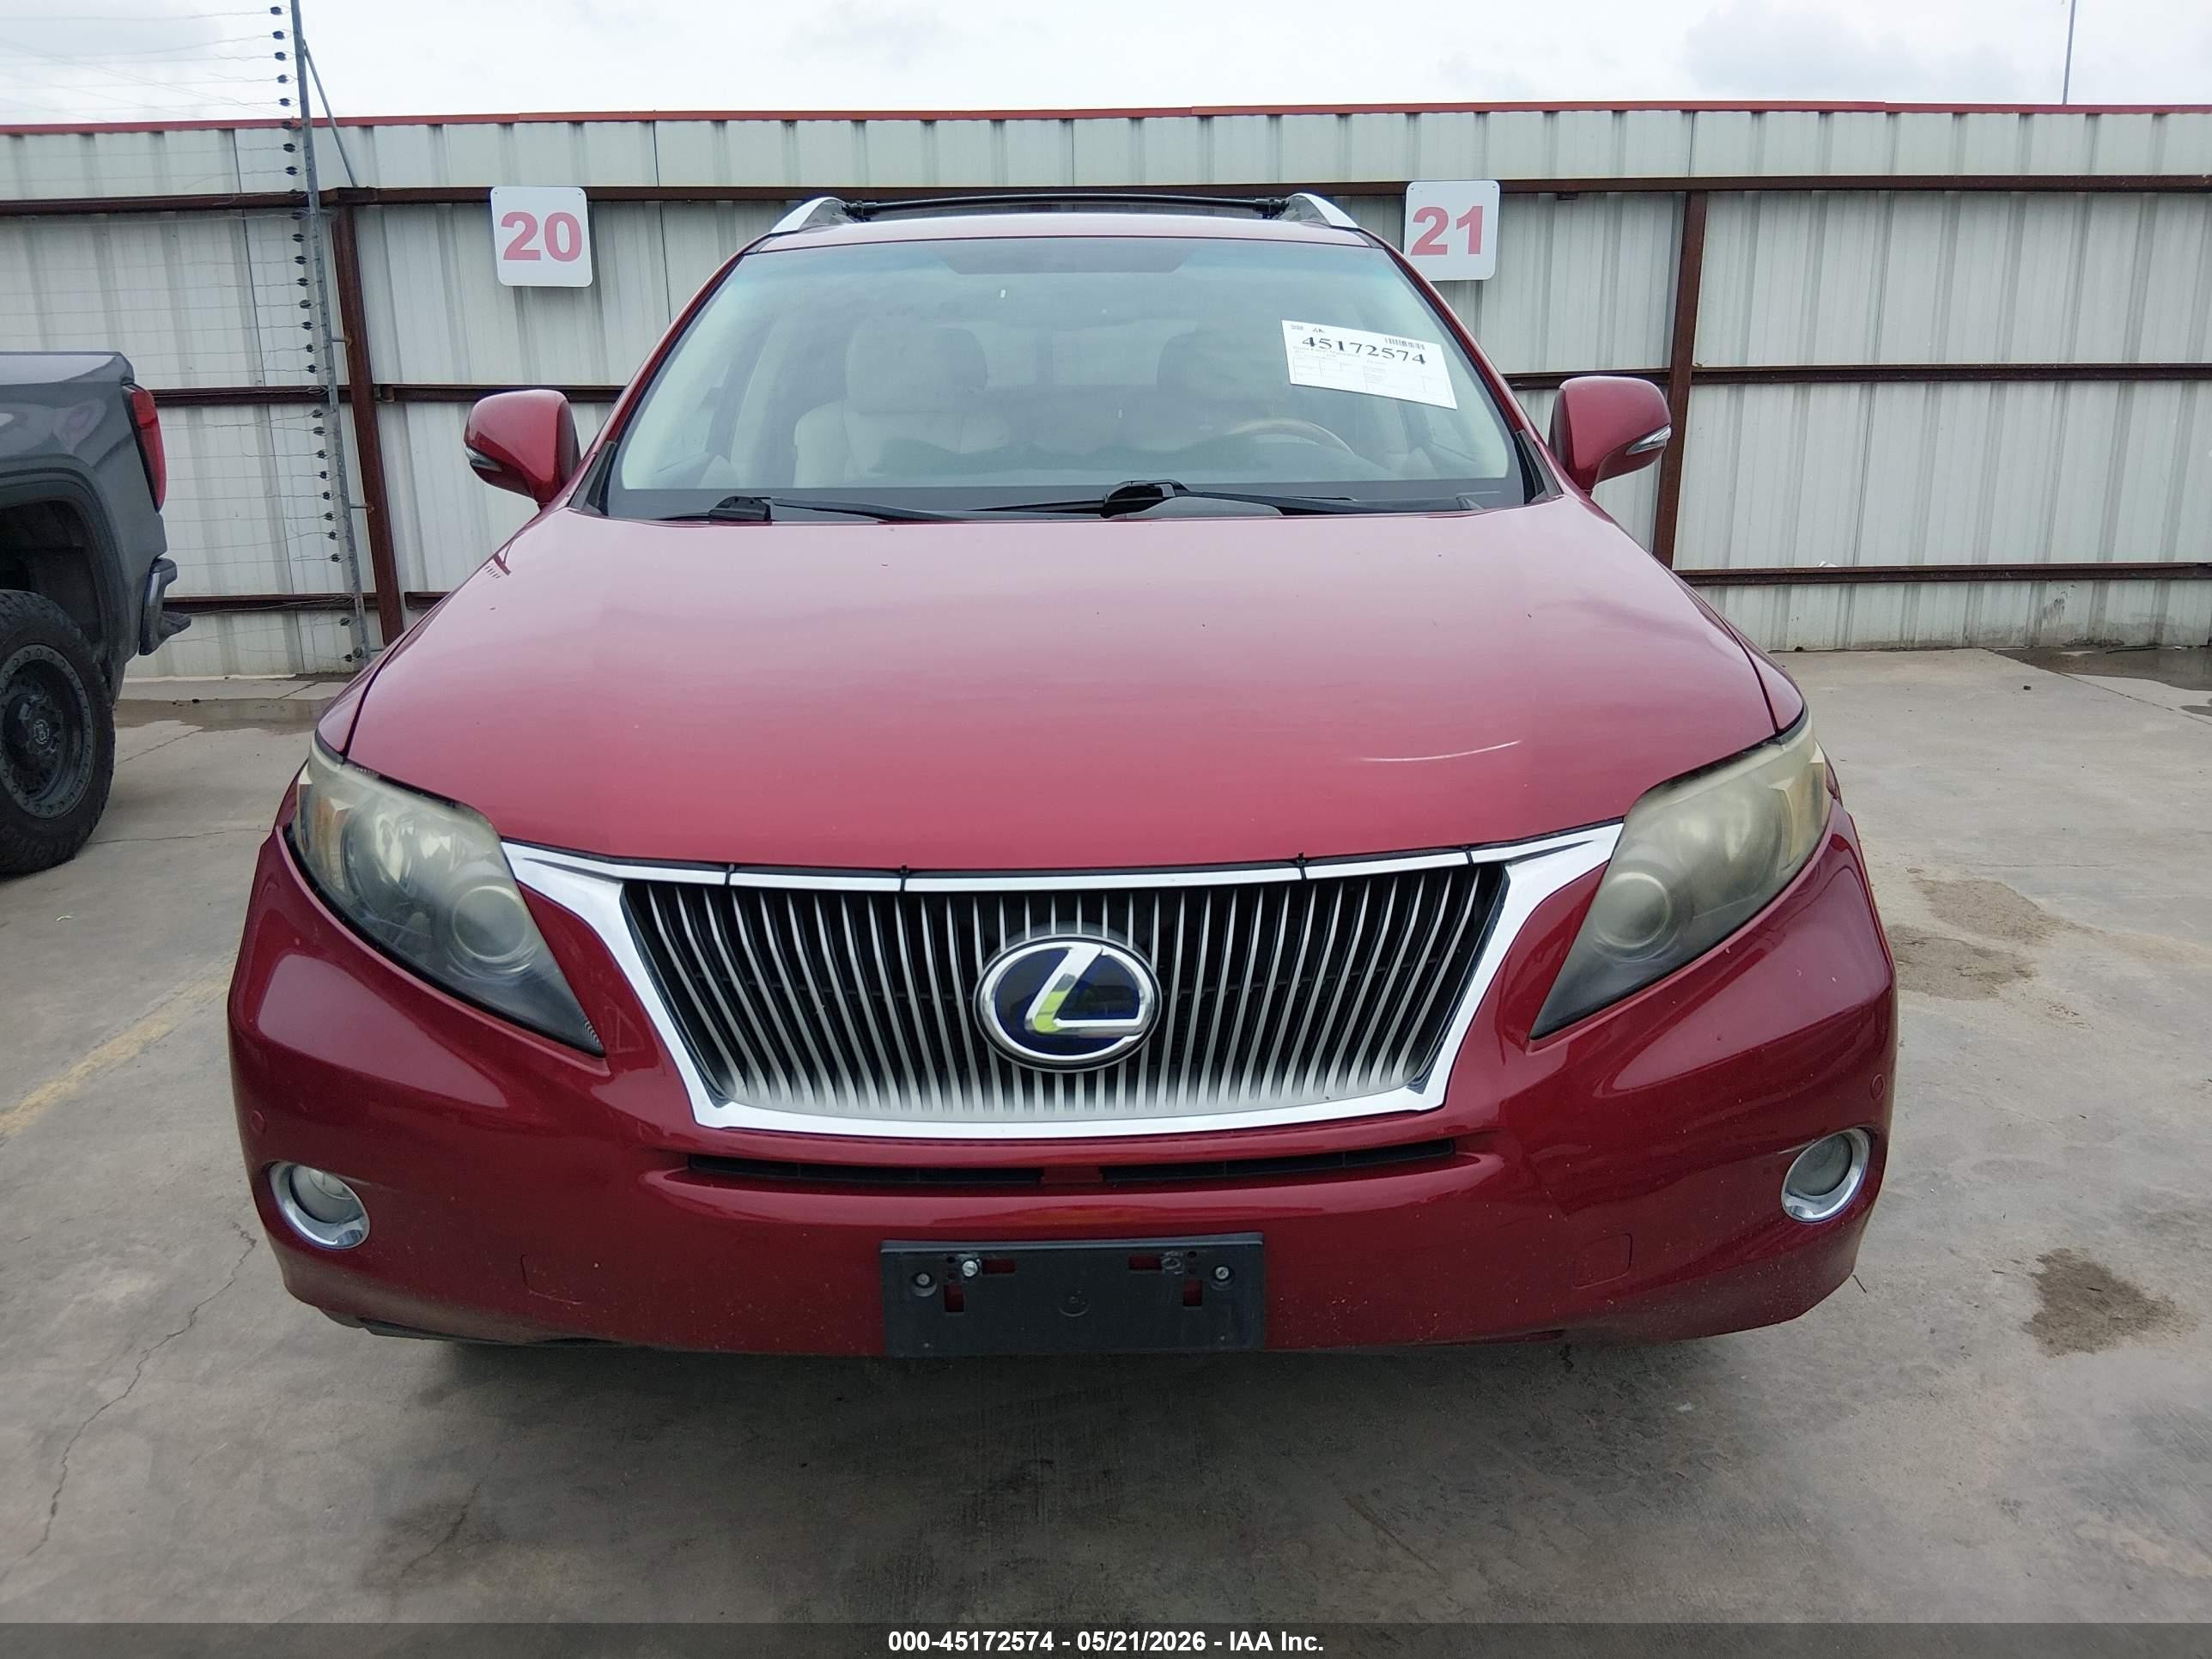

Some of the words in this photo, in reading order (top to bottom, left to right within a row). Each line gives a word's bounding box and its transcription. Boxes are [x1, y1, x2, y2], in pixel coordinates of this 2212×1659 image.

[501, 211, 583, 262] 20
[1410, 205, 1484, 256] 21
[1302, 336, 1426, 365] 45172574
